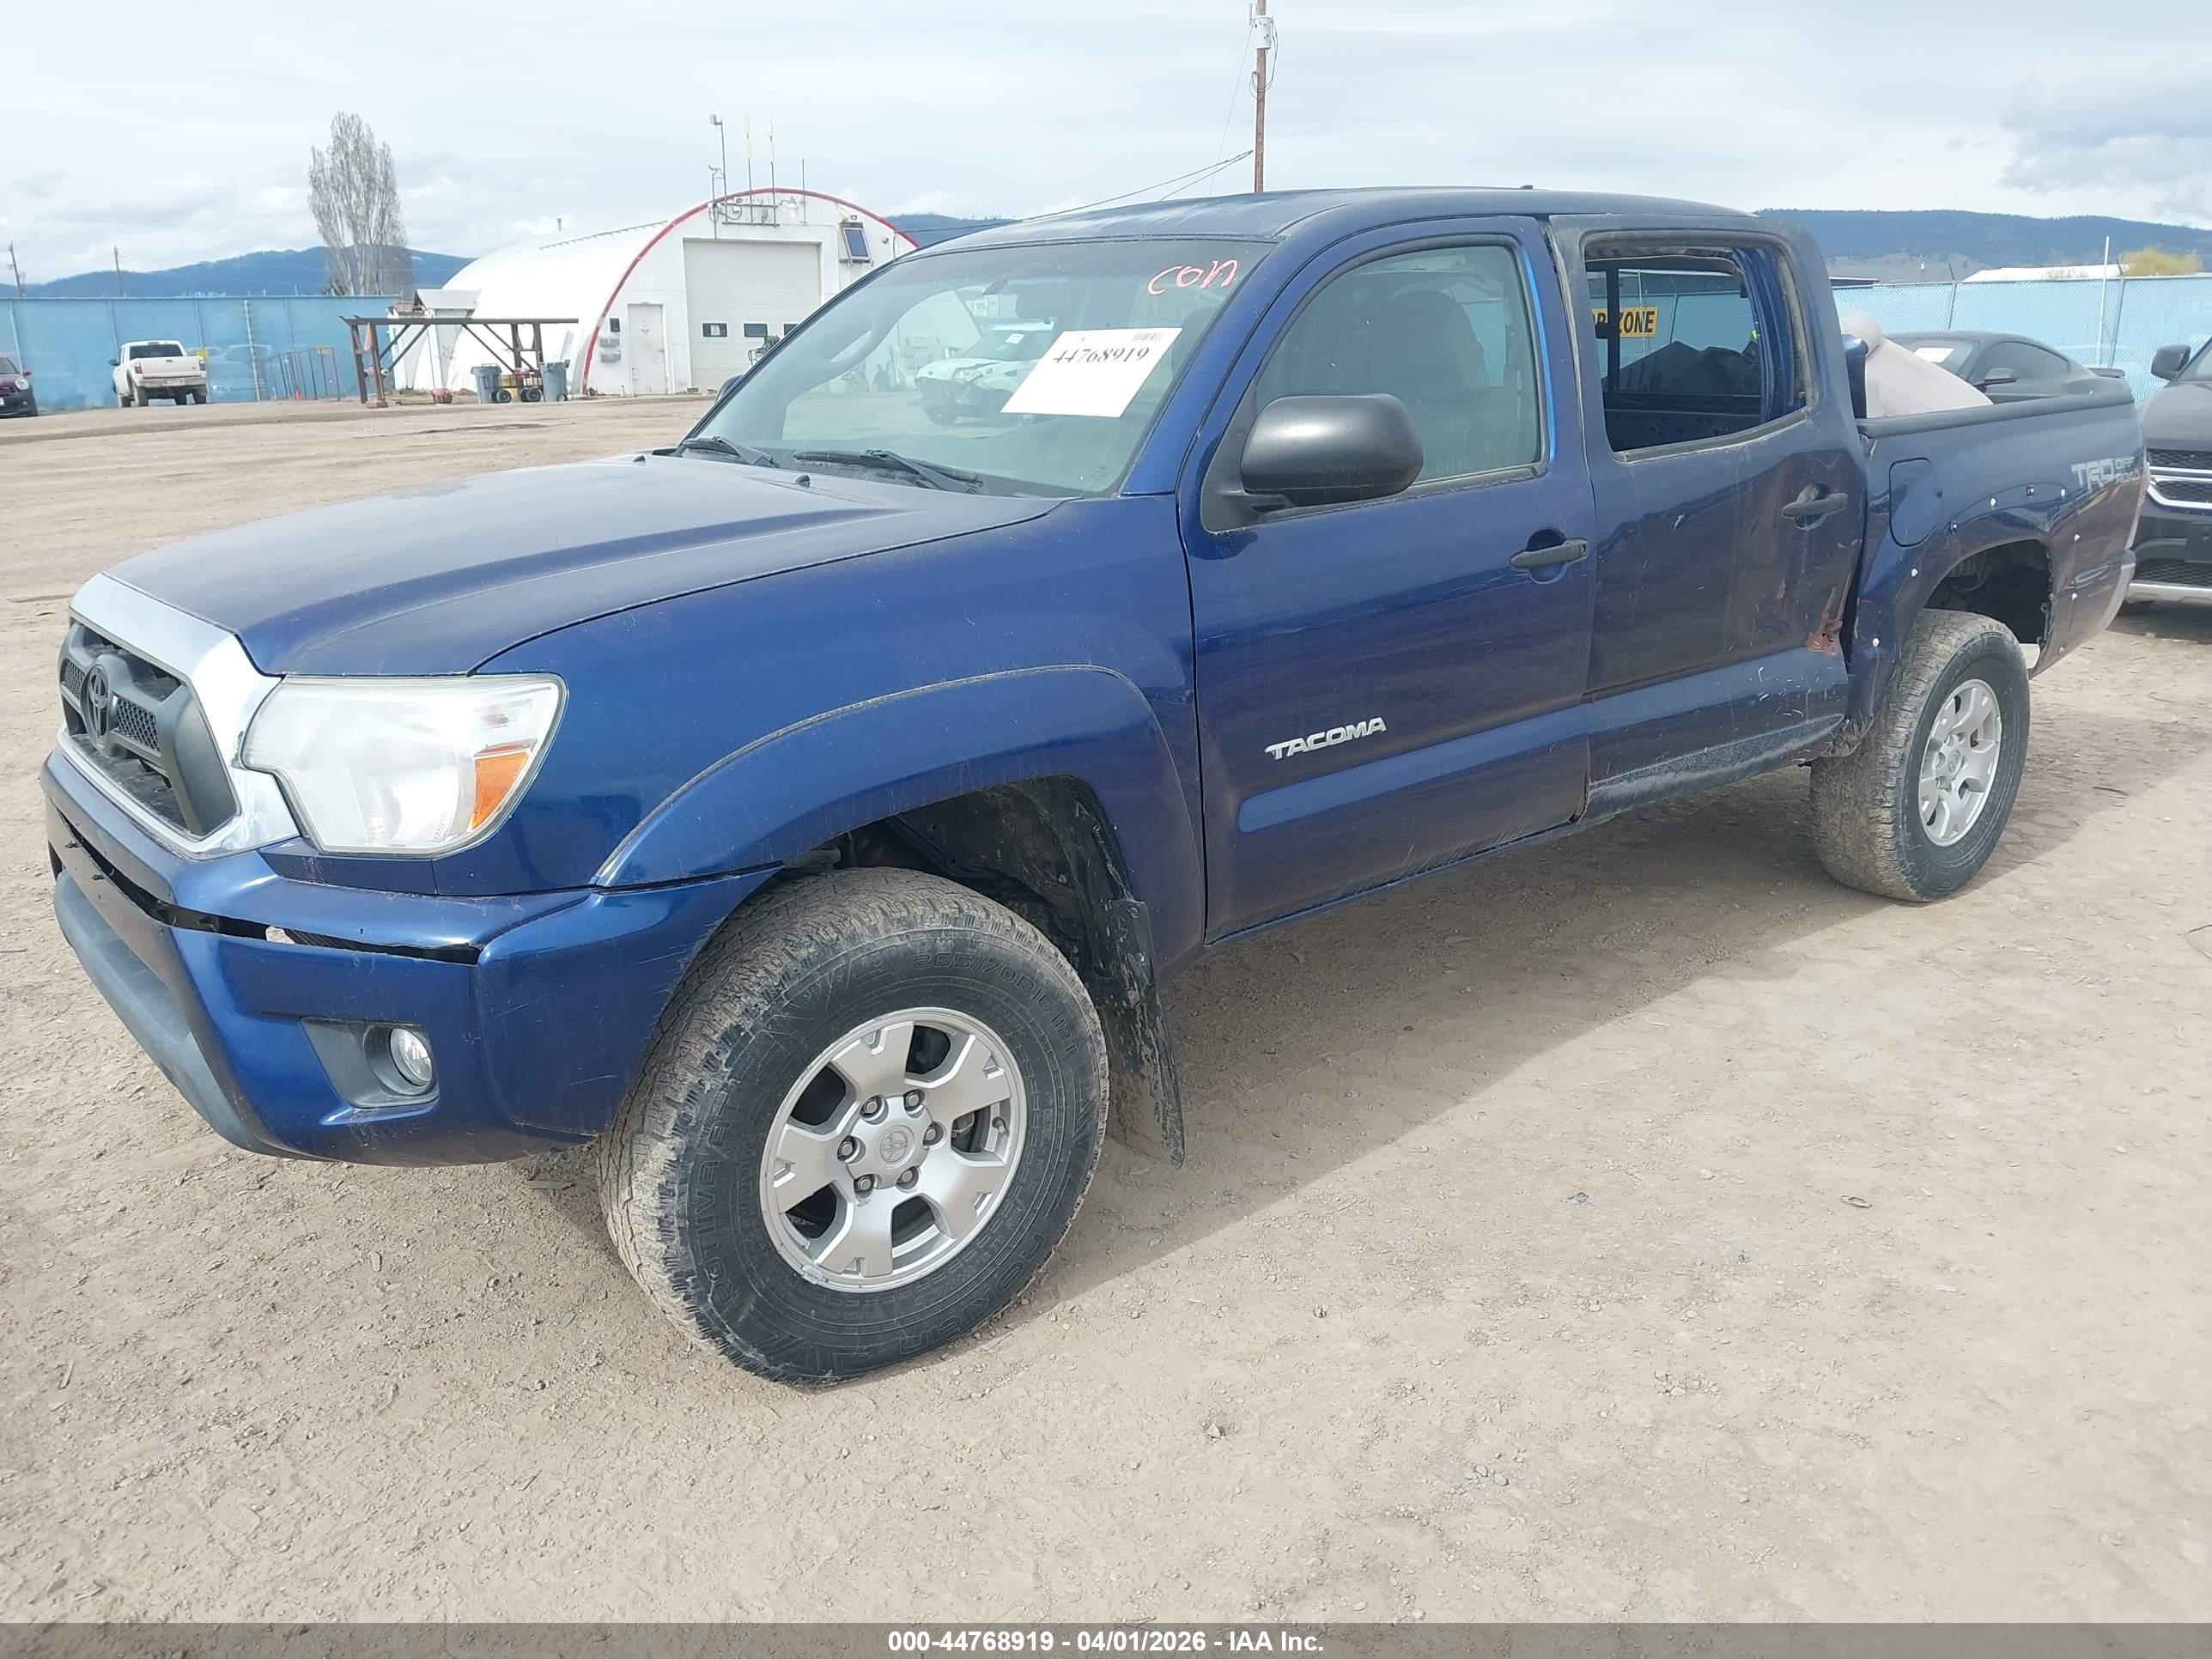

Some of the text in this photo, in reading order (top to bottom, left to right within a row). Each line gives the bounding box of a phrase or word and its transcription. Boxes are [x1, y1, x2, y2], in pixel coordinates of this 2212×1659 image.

[1052, 346, 1150, 365] 44768919
[2071, 459, 2115, 493] TRD
[1264, 717, 1388, 760] TACOMA
